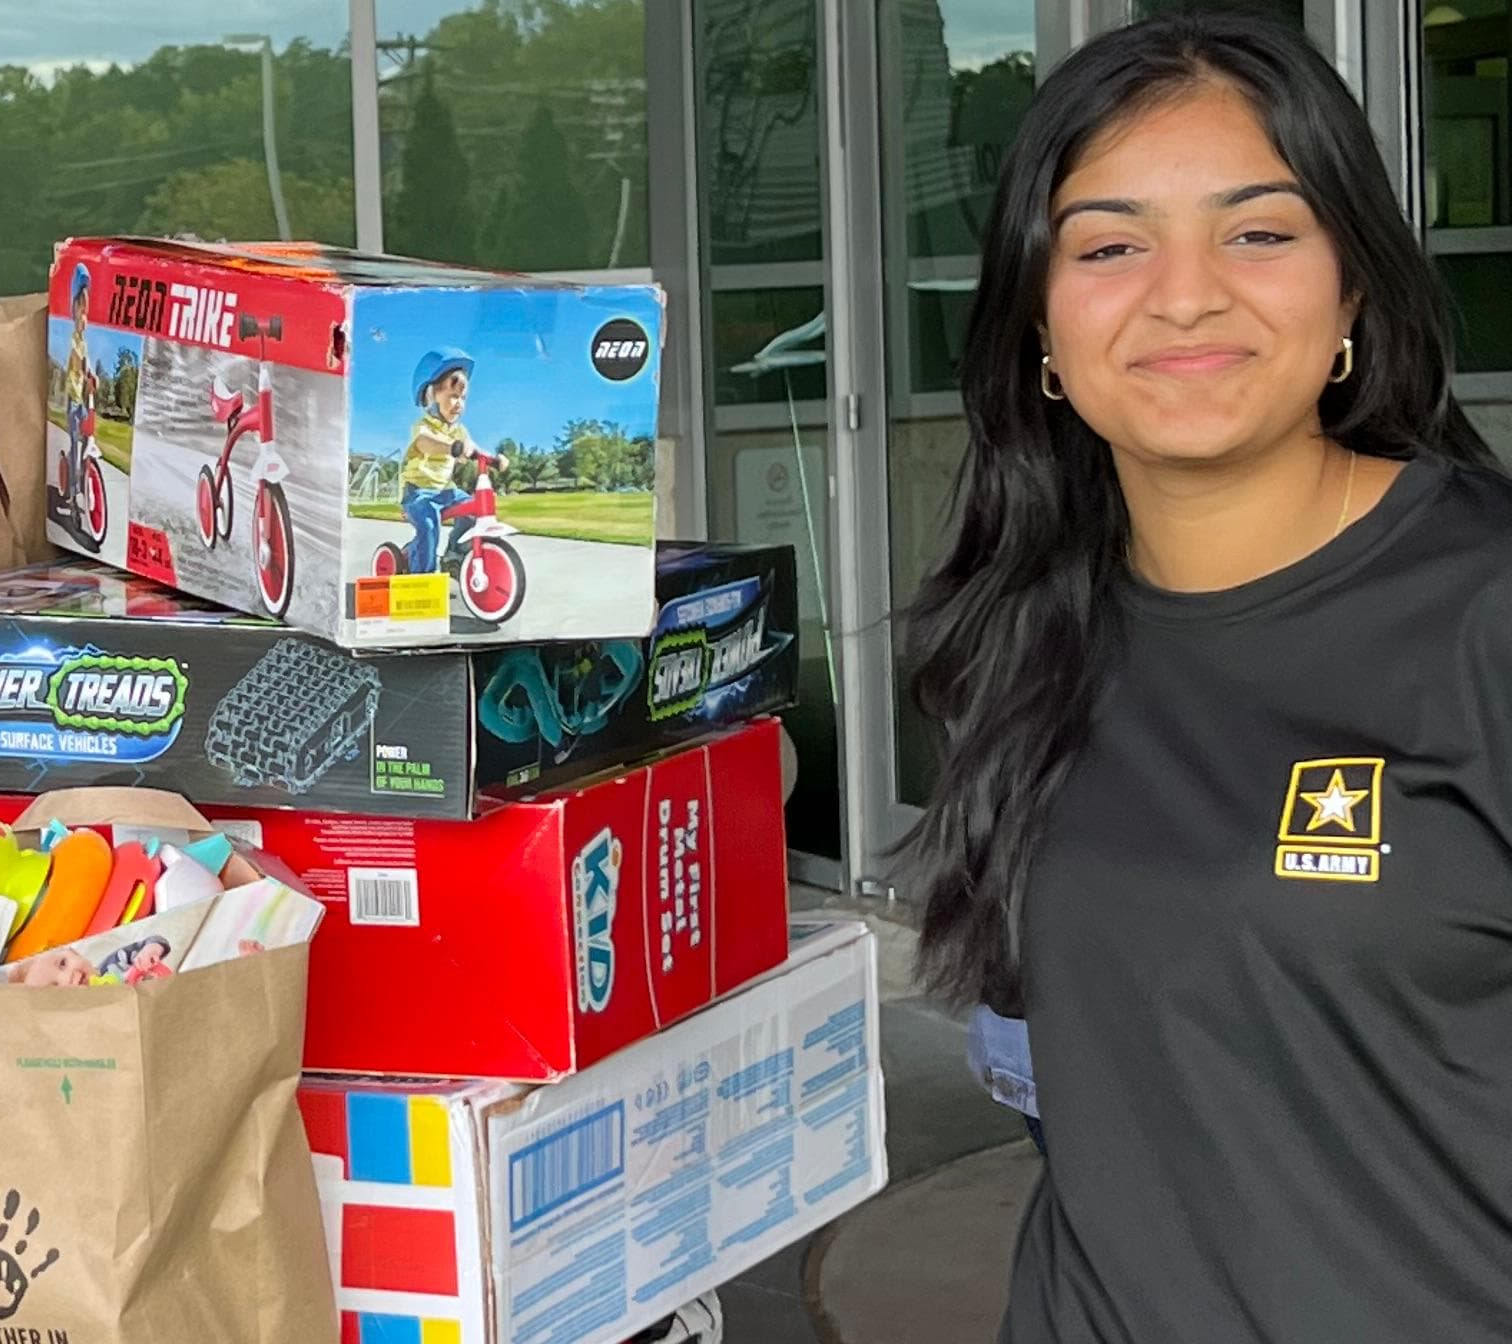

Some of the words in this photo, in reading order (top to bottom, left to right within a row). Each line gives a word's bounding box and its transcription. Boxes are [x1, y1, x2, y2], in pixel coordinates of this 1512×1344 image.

[168, 282, 238, 348] TRIKE
[594, 339, 647, 358] NEON
[64, 672, 175, 717] TREADS
[58, 730, 118, 755] VEHICLES
[659, 799, 672, 901] Drum
[584, 837, 613, 1004] KID
